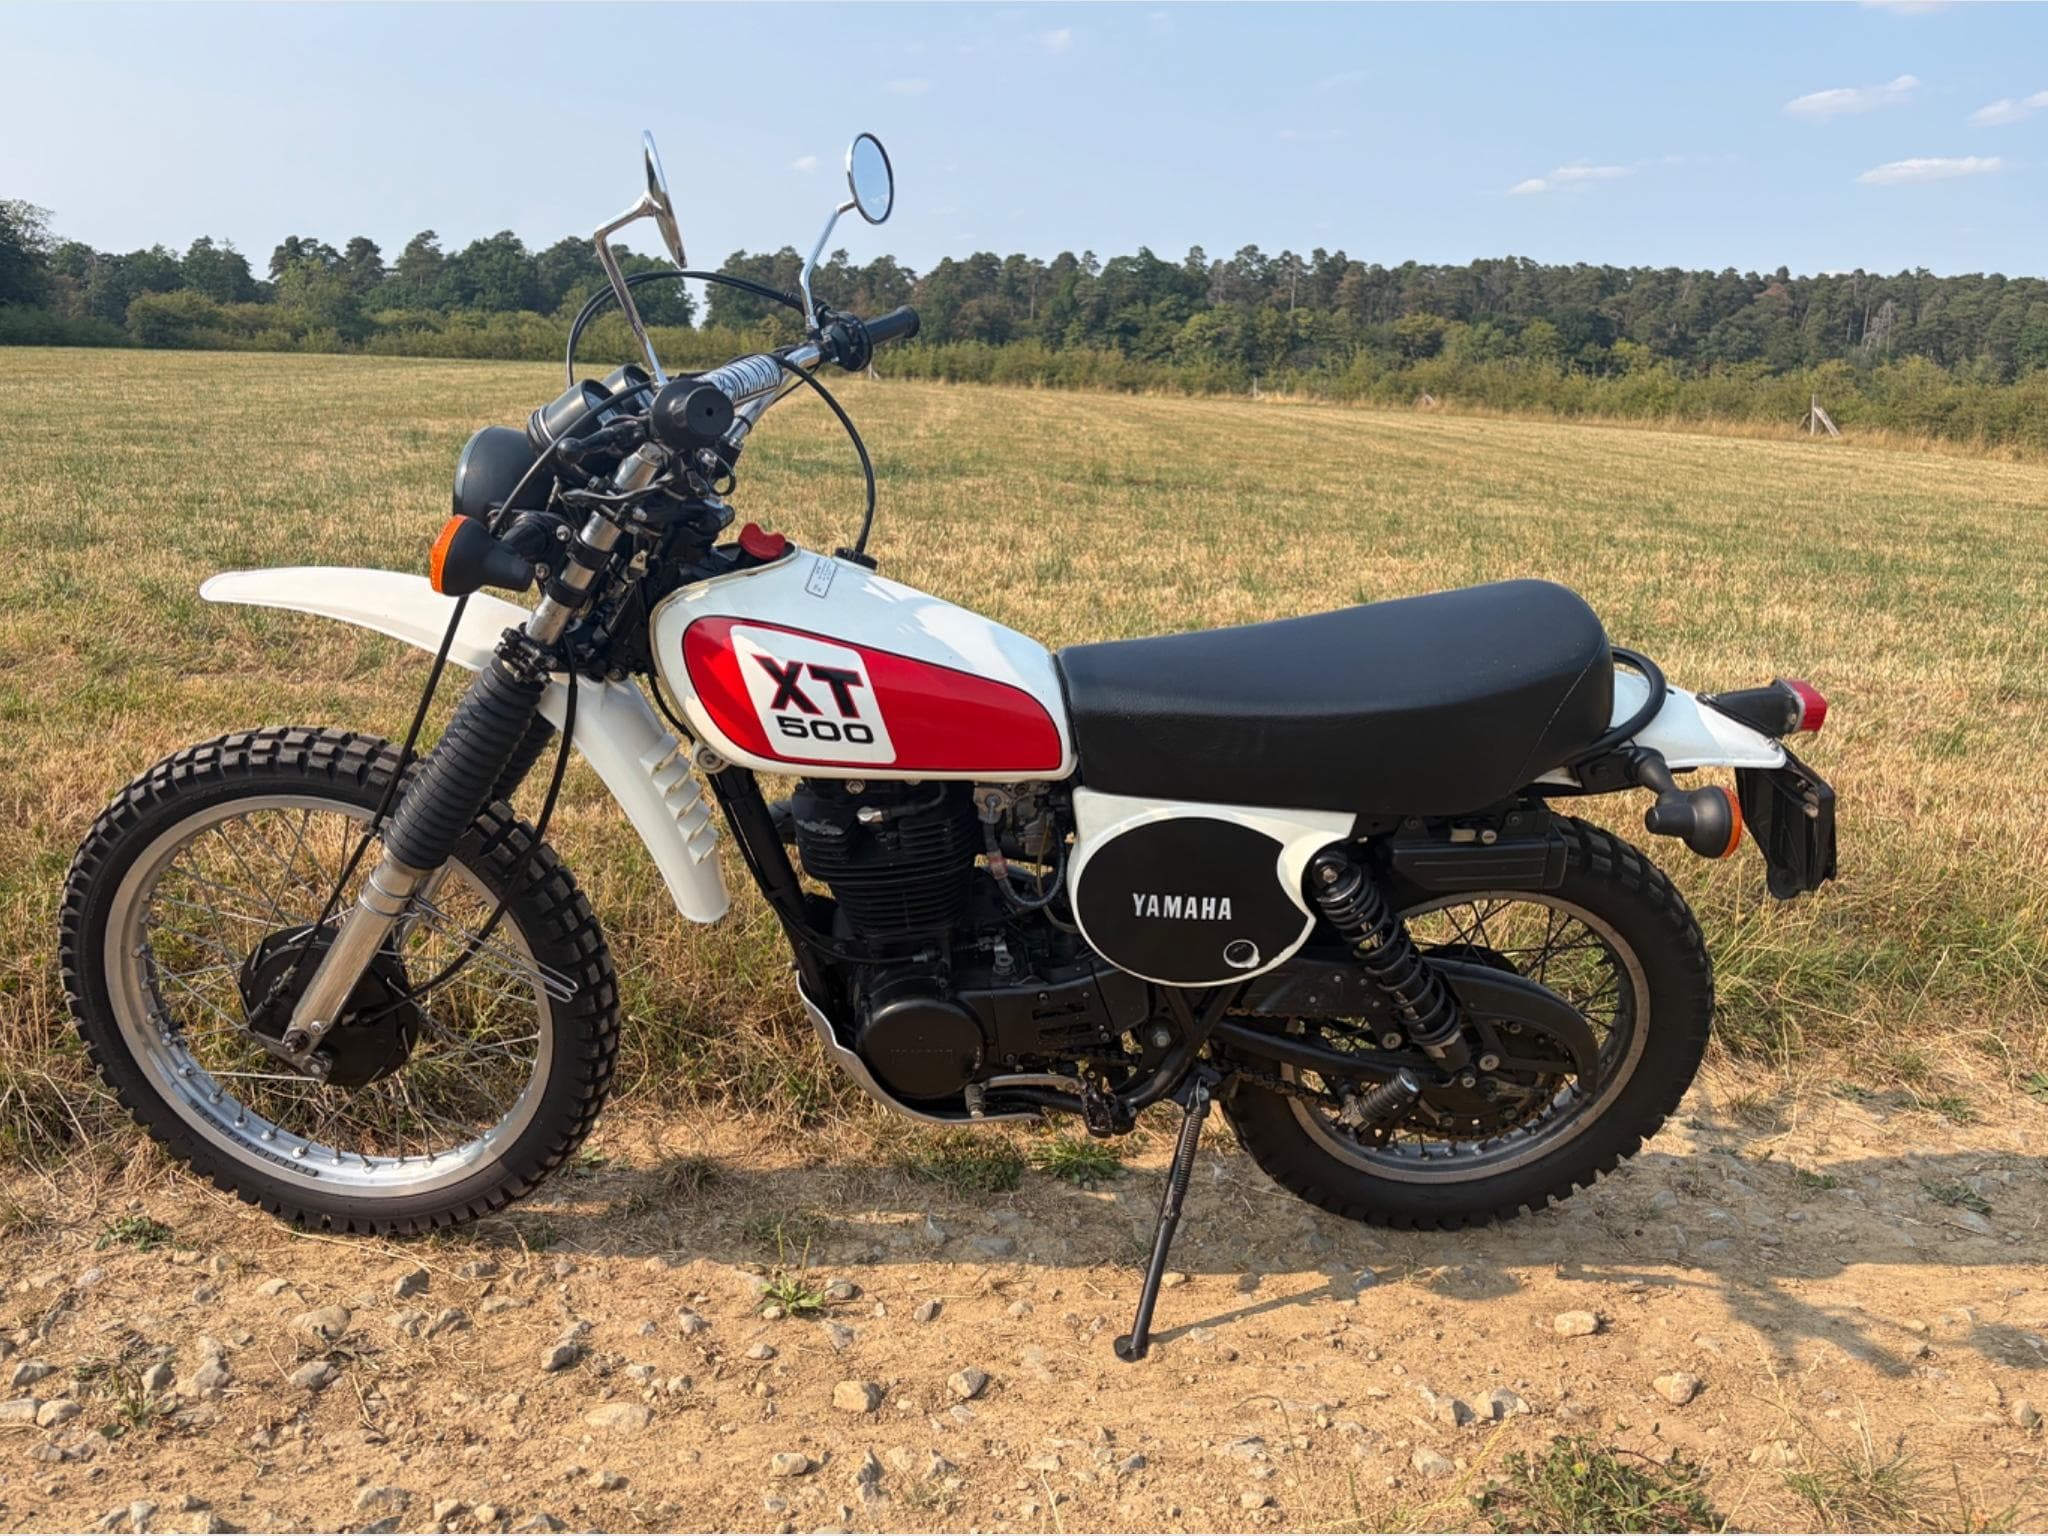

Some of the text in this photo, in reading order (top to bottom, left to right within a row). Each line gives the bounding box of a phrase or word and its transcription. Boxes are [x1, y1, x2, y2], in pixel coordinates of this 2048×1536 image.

[751, 653, 864, 719] XT
[776, 715, 874, 744] 500
[1132, 893, 1232, 920] YAMAHA
